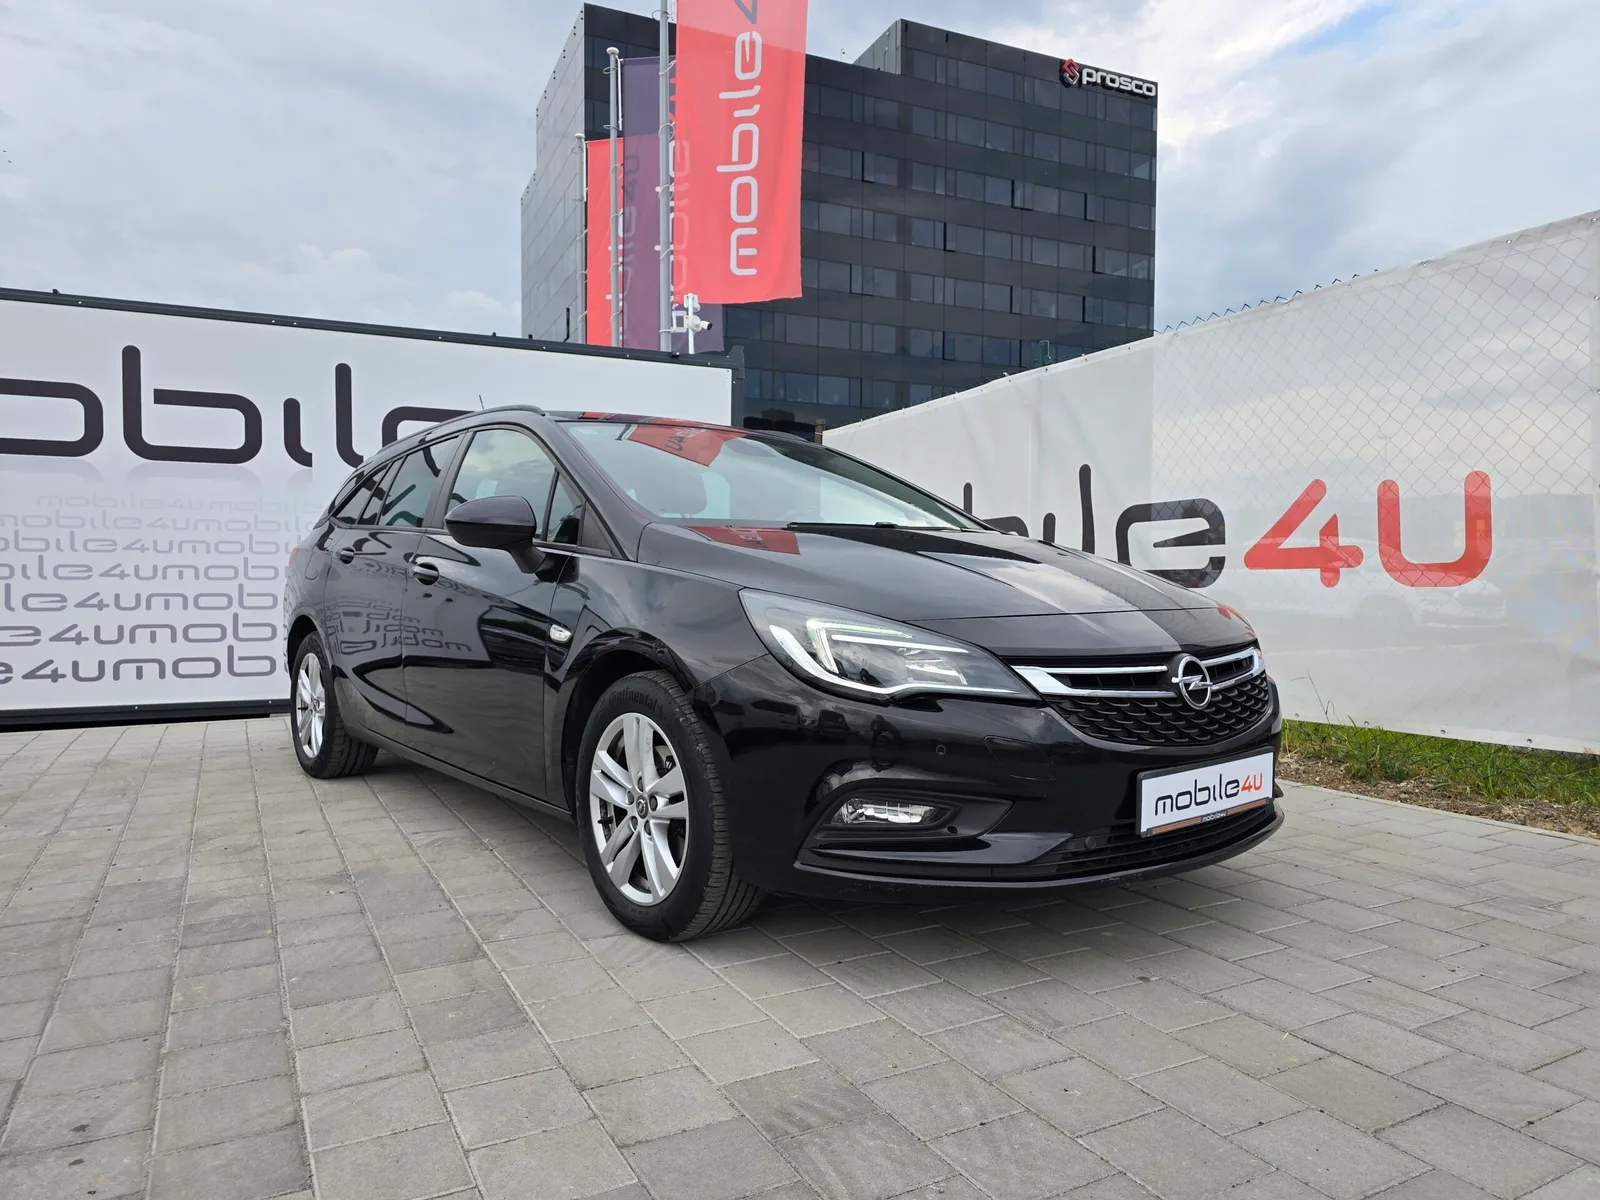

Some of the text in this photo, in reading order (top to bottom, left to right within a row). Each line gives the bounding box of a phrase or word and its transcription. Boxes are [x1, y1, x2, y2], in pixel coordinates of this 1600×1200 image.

[1082, 67, 1156, 97] prosco
[0, 644, 277, 685] 4umob
[1154, 773, 1263, 816] mobile4U
